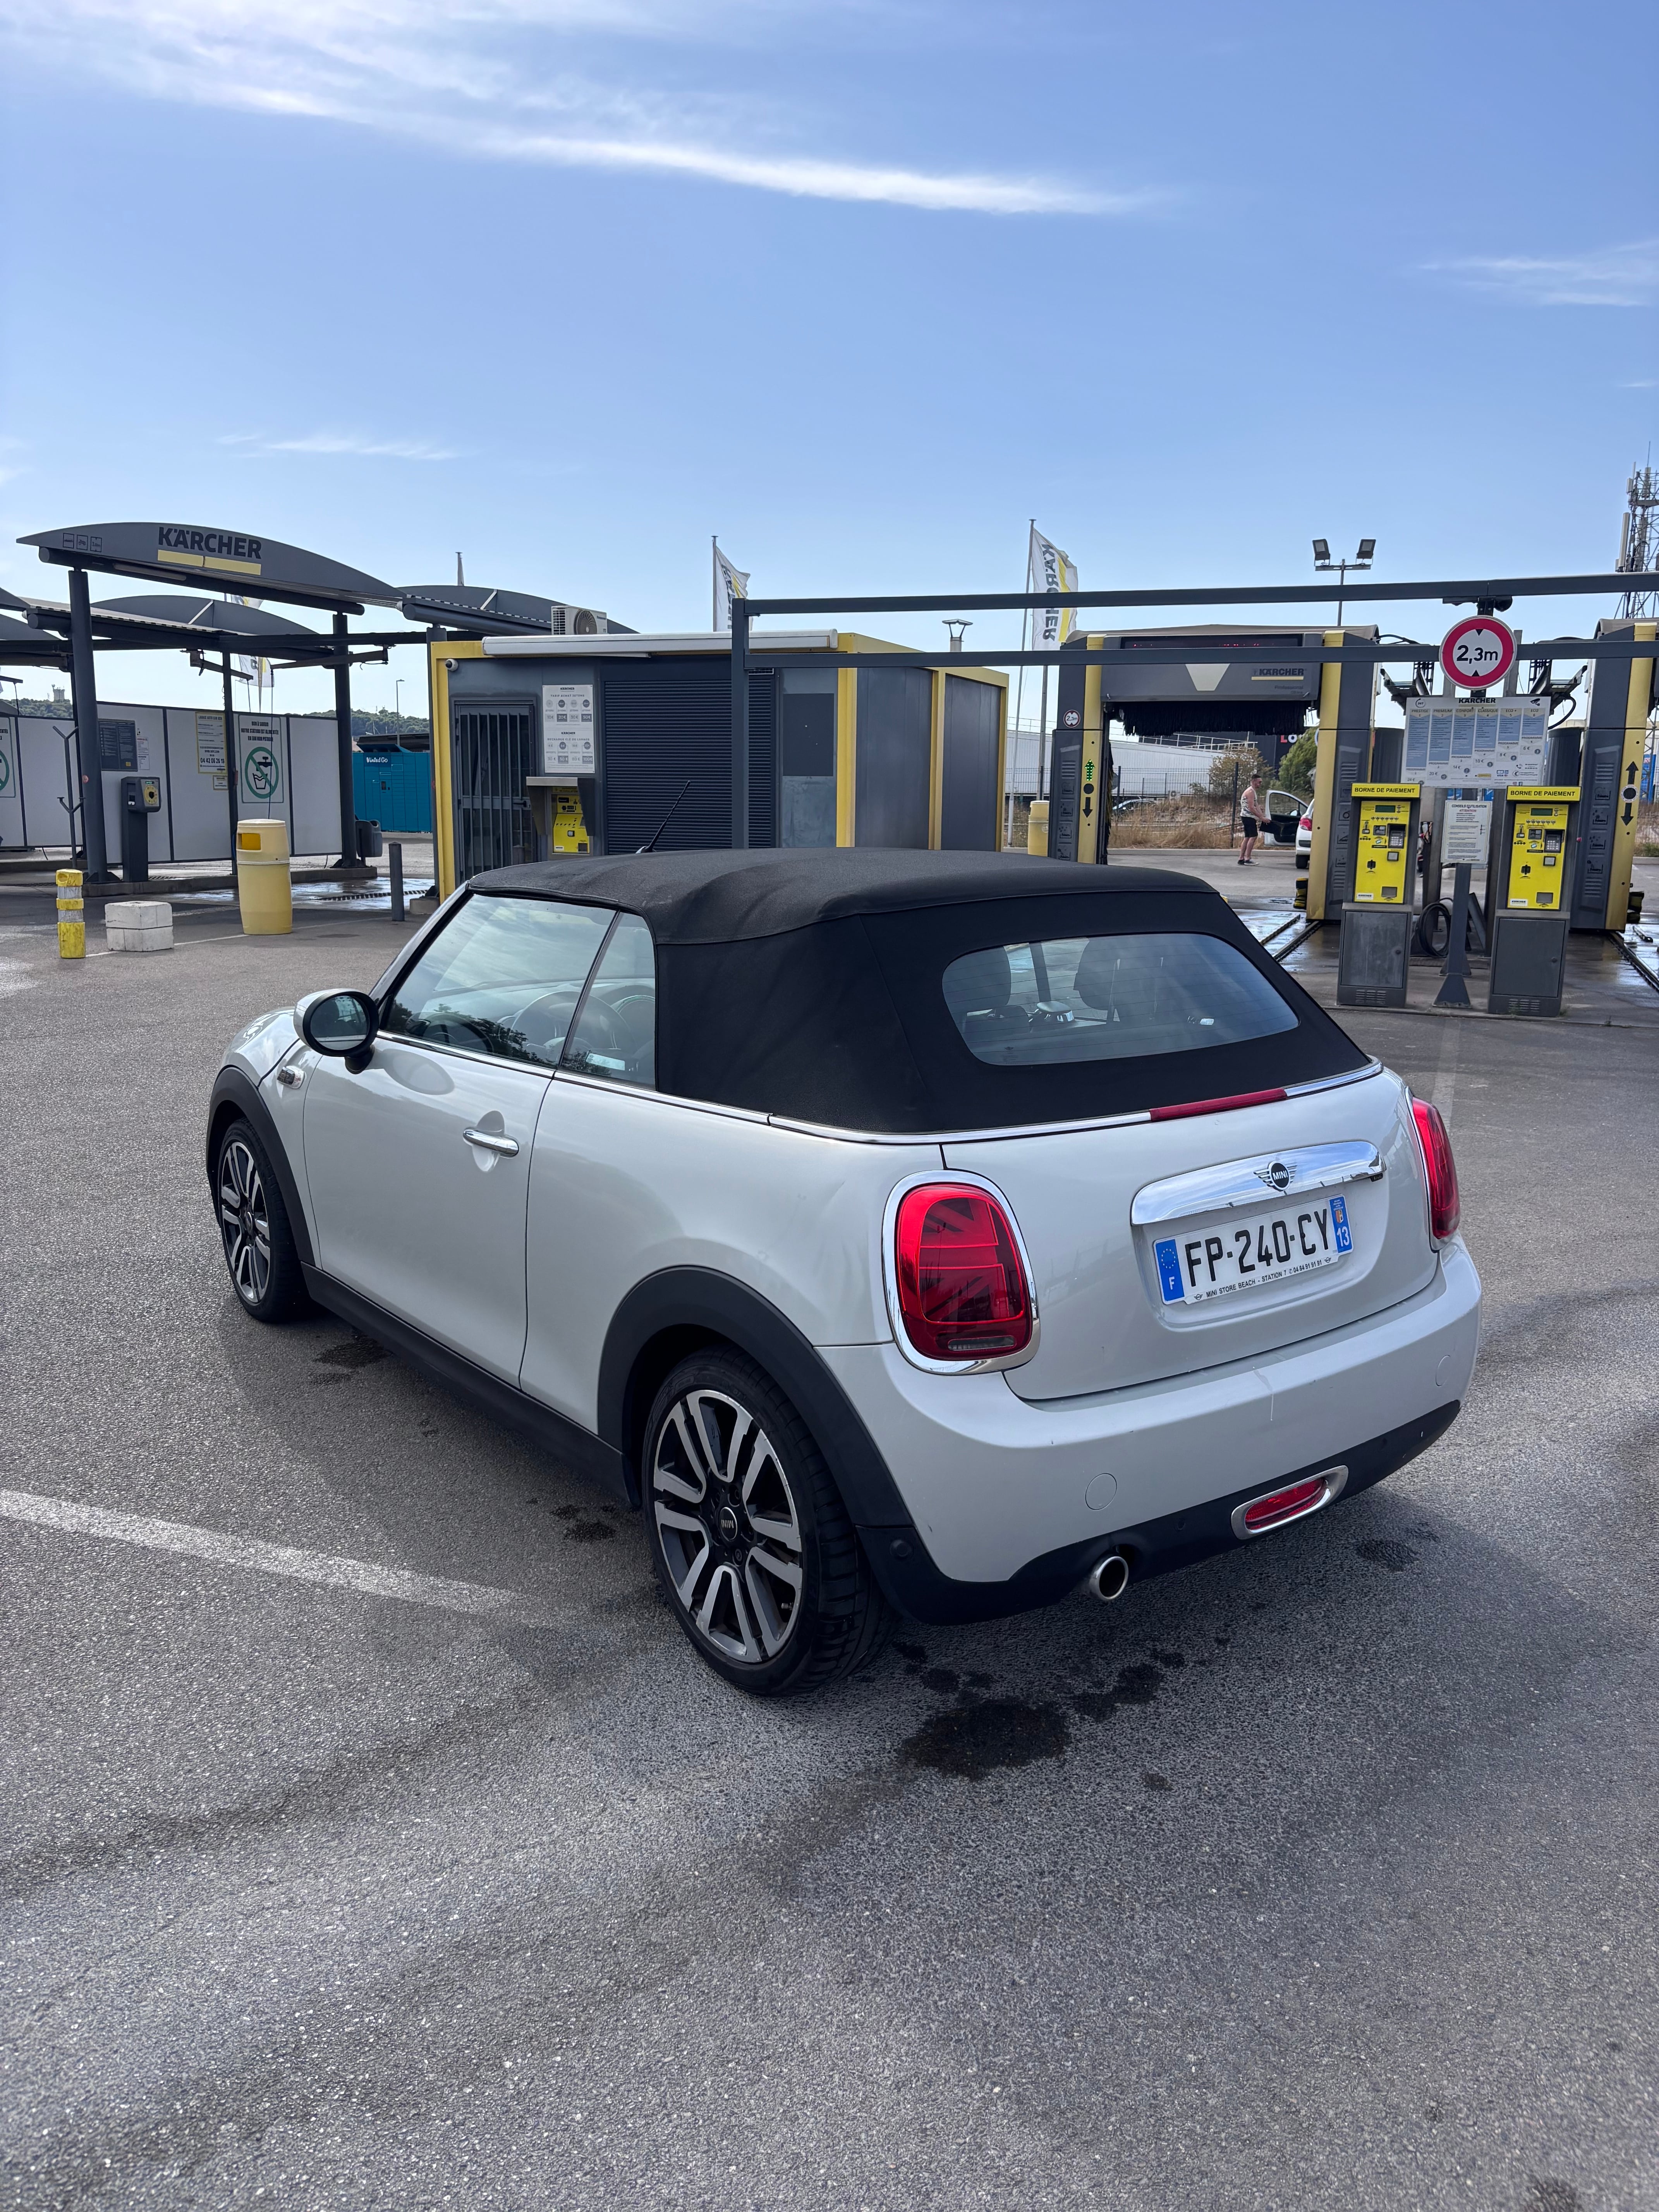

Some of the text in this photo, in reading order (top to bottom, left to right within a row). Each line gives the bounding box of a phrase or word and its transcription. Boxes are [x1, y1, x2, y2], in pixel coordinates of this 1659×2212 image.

[158, 527, 261, 559] KÄRCHER
[1456, 645, 1498, 664] 2,3m
[1273, 1170, 1288, 1180] MINI
[1337, 1226, 1350, 1247] 13
[1185, 1208, 1328, 1287] FP-240-CY
[1169, 1276, 1175, 1290] F
[1206, 1289, 1217, 1298] MINI
[1219, 1284, 1237, 1294] STORE
[1238, 1279, 1256, 1288] BEACH
[1262, 1271, 1283, 1282] STATION
[721, 1519, 734, 1528] MINI
